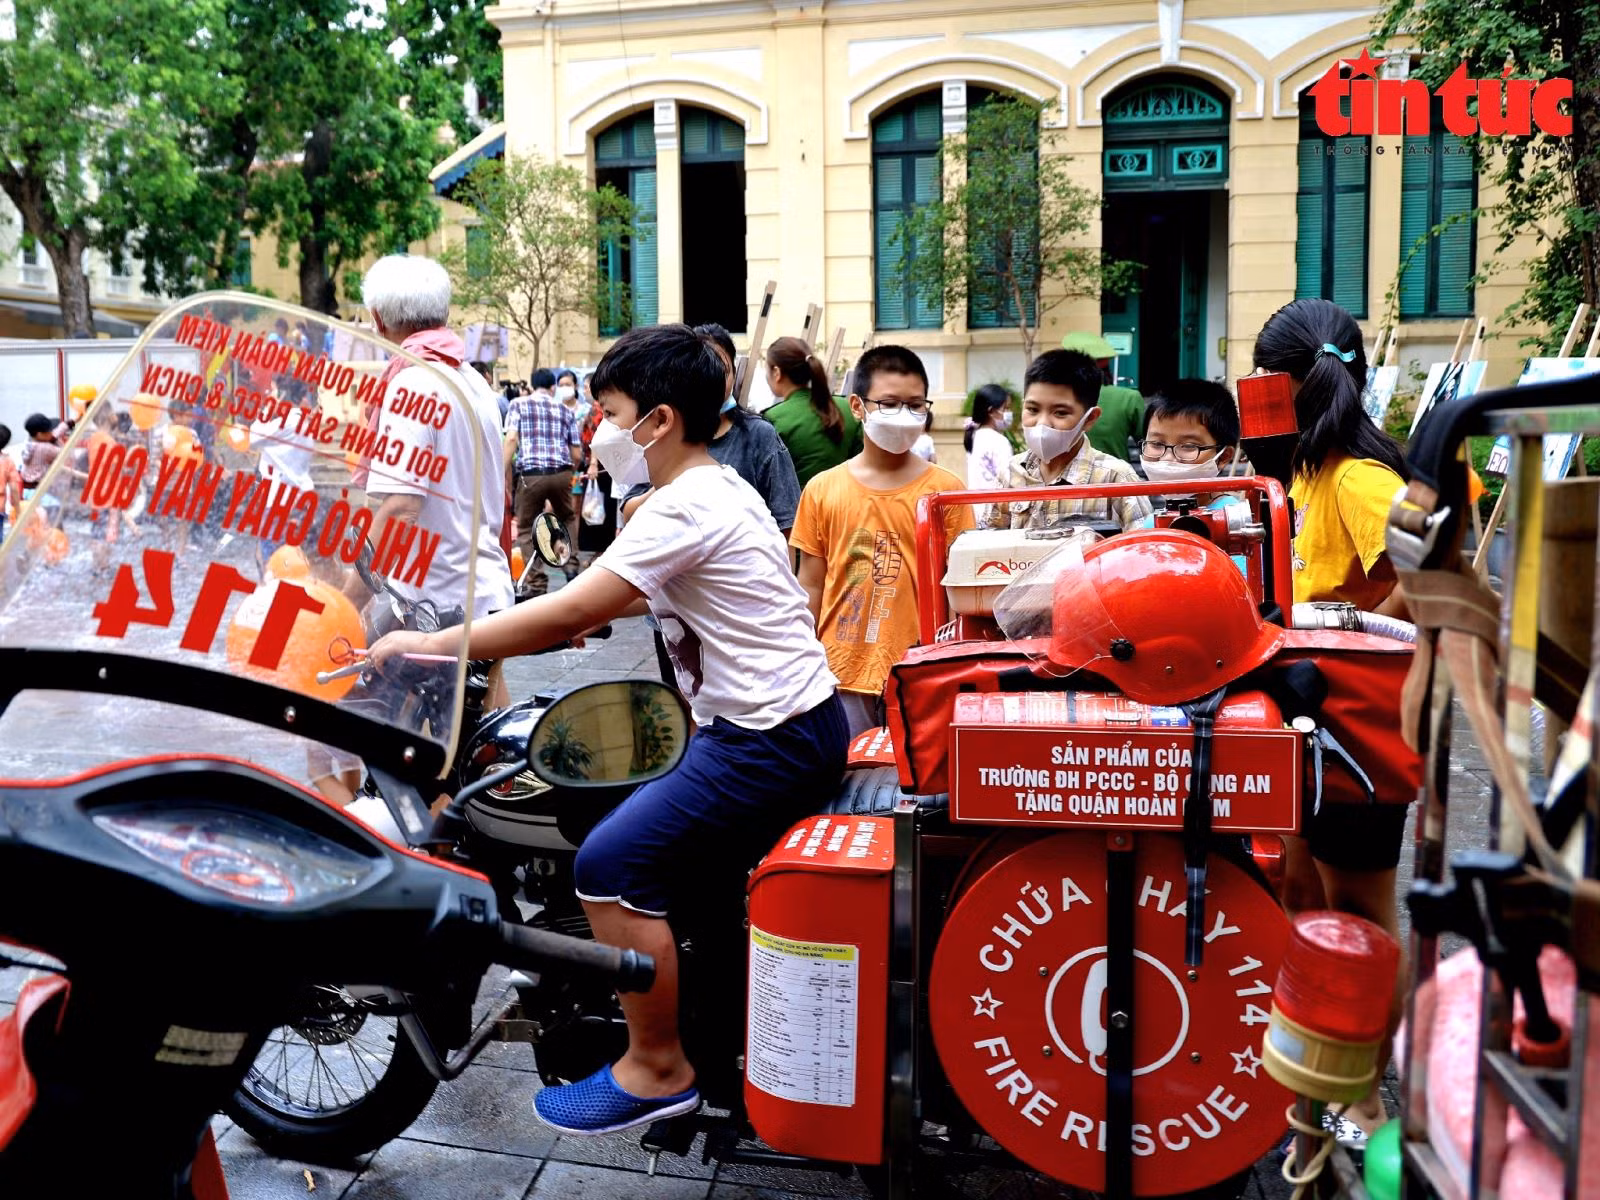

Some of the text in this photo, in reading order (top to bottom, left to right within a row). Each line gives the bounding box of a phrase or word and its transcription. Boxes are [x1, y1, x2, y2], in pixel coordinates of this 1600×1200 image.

[1051, 740, 1193, 767] SẢN PHẨM CỦA
[978, 764, 1050, 788] TRƯỜNG
[1055, 768, 1080, 789] ĐH
[1085, 769, 1135, 790] PCCC
[1153, 769, 1179, 796] BỘ
[1243, 774, 1271, 794] AN
[1015, 791, 1063, 816] TẶNG
[1068, 792, 1119, 818] QUẬN
[1124, 792, 1177, 817] HOÀN
[979, 876, 1093, 972] CHỮA
[1228, 955, 1273, 1026] 114
[973, 1036, 1059, 1128] FIRE
